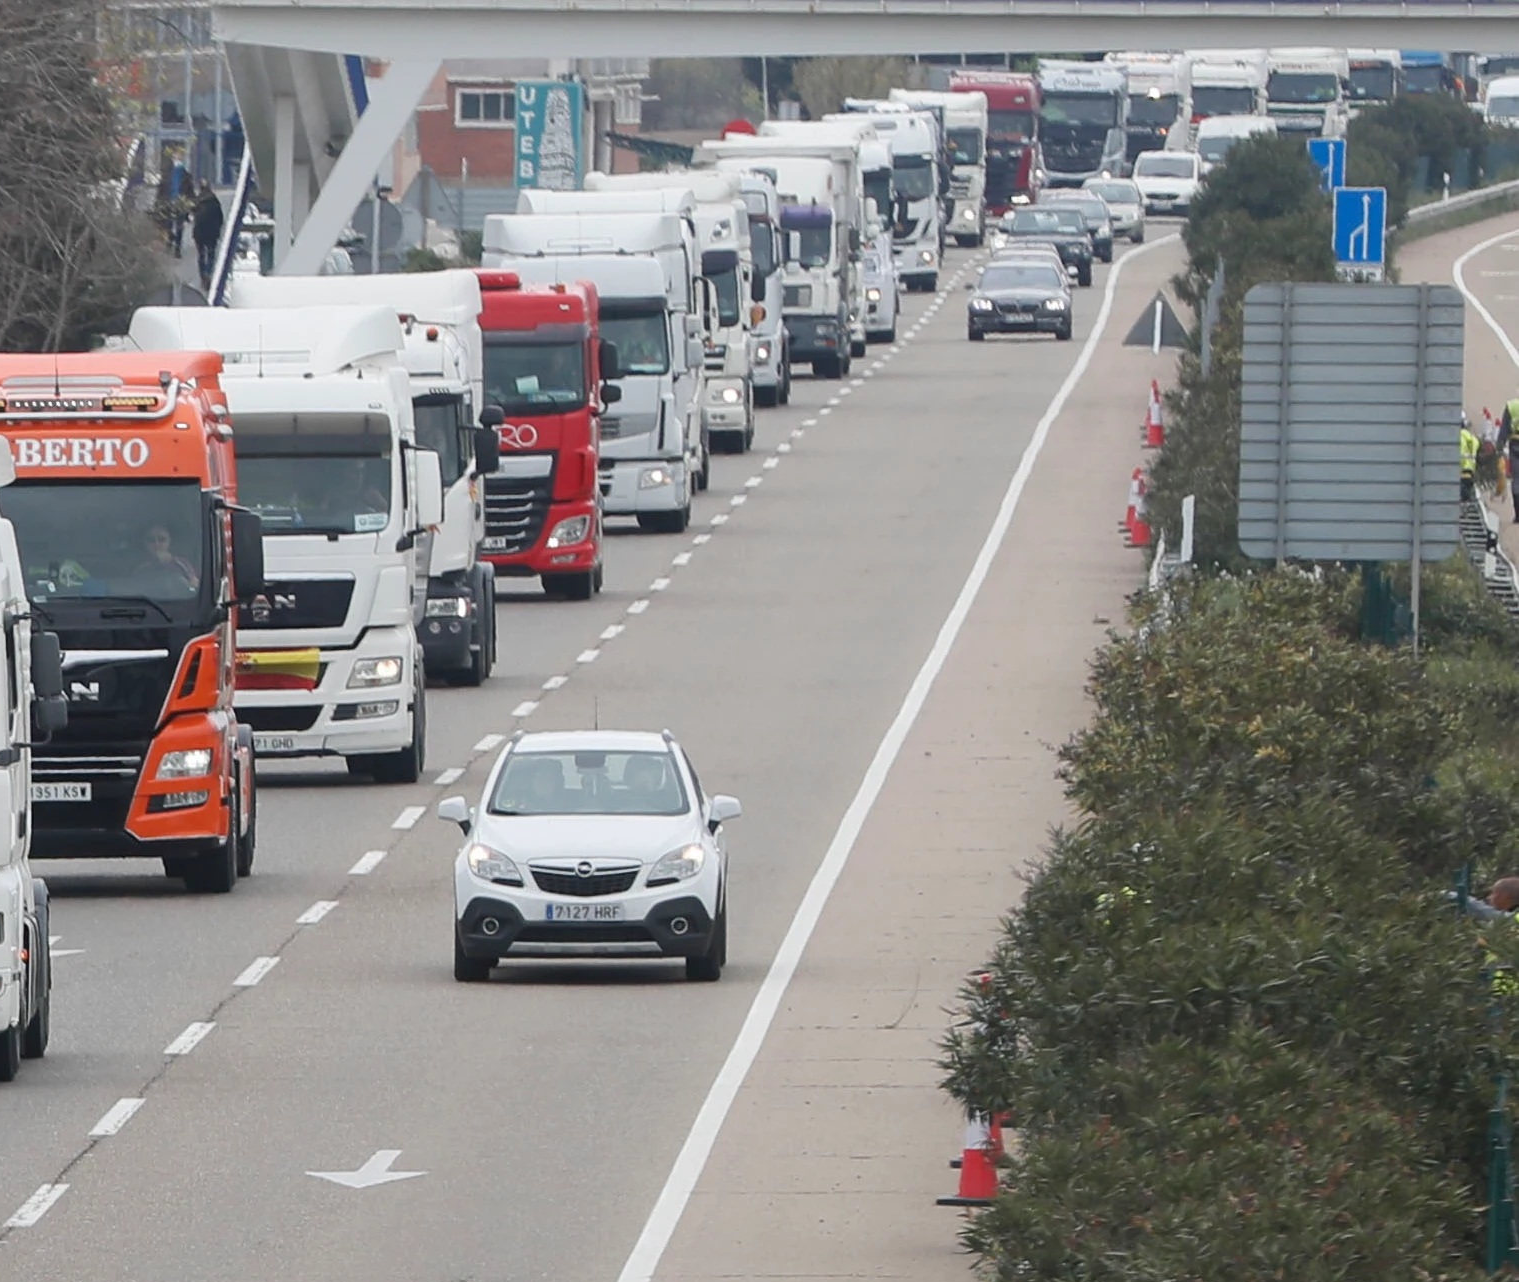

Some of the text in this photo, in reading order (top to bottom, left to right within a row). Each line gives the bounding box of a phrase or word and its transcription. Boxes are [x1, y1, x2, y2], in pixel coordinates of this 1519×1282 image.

[11, 437, 150, 468] BERTO
[555, 905, 620, 919] 7127 HRF
